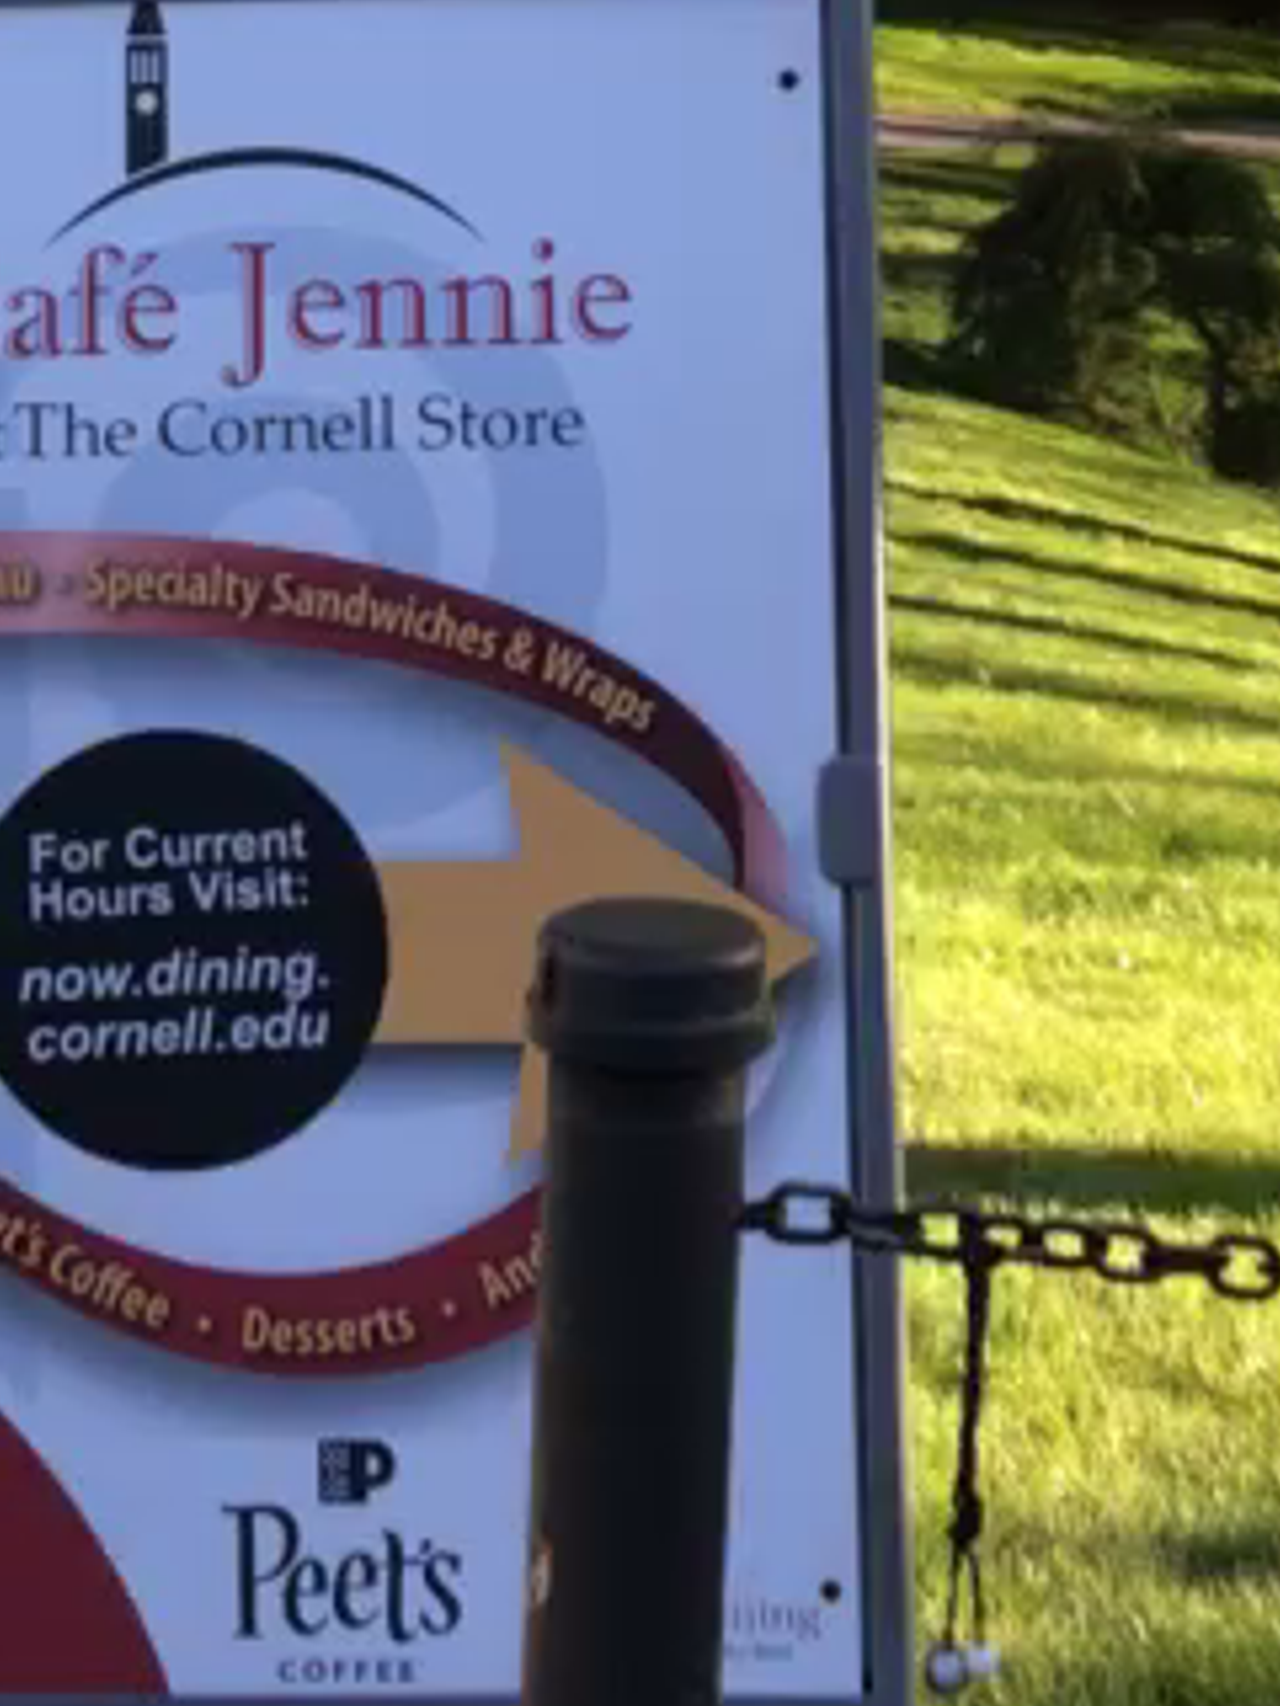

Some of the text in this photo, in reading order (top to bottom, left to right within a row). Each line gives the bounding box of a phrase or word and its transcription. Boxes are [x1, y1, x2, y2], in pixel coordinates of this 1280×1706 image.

[220, 238, 633, 387] Jennie
[13, 402, 137, 459] The
[157, 394, 394, 458] Cornell
[416, 388, 584, 450] Store
[85, 555, 263, 621] Specialty
[272, 573, 495, 663] Sandwiches
[503, 626, 536, 672] &
[542, 639, 656, 731] Wraps
[28, 820, 308, 874] For Current
[29, 868, 310, 921] Hours Visit:
[20, 946, 330, 1003] now.dining.
[28, 1006, 331, 1061] cornell.edu
[49, 1242, 171, 1329] Coffee
[240, 1304, 415, 1355] Desserts
[220, 1502, 462, 1644] Peet's
[275, 1658, 417, 1683] COFFEE
